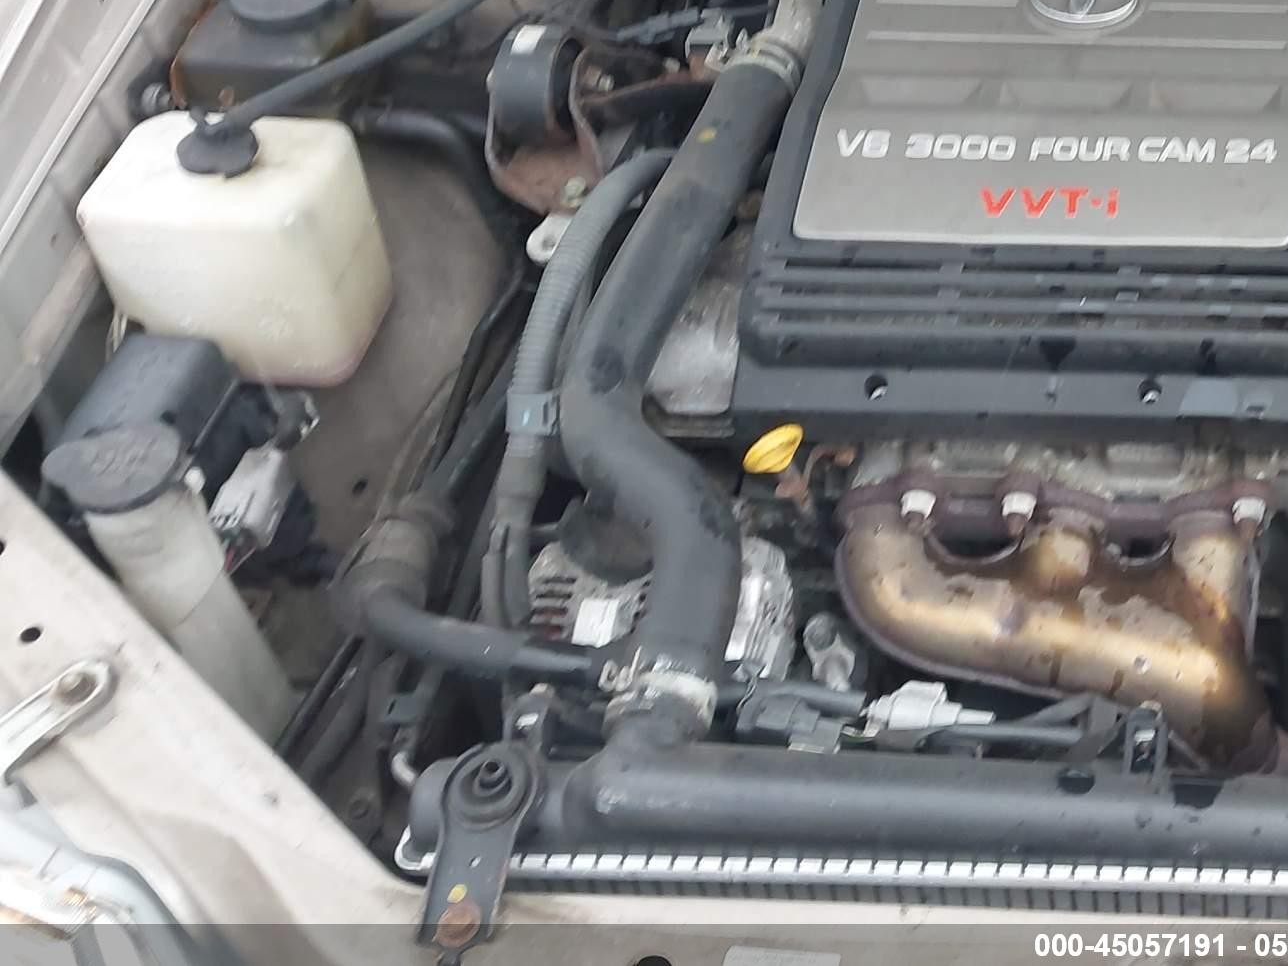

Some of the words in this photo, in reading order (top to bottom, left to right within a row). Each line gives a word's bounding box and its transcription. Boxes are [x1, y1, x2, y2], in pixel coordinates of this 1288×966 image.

[837, 129, 891, 158] V6
[905, 133, 1017, 161] 3000
[1029, 135, 1131, 162] FOUR
[1137, 137, 1216, 163] CAM
[1223, 138, 1278, 164] 24
[978, 185, 1121, 219] VVT-i
